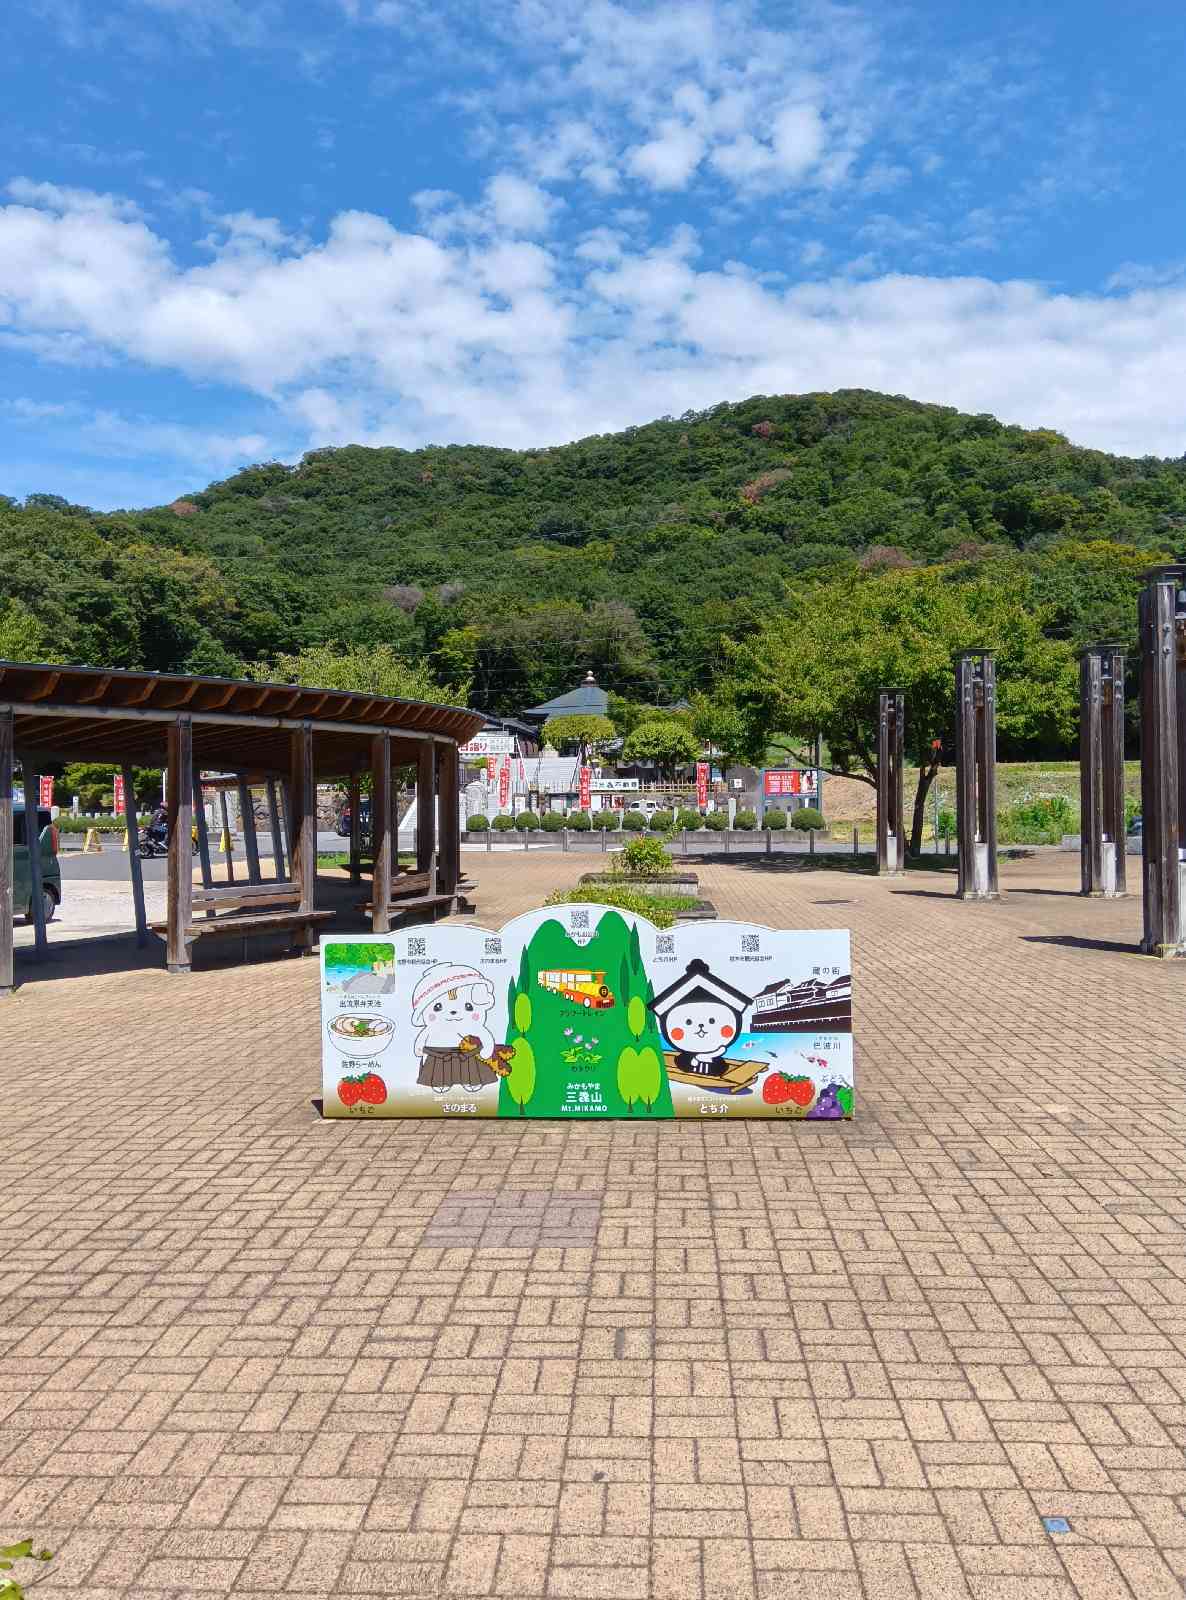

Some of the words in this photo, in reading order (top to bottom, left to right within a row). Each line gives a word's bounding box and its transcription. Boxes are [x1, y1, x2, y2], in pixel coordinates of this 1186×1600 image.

[812, 966, 840, 976] 蔵の街
[341, 1060, 382, 1069] 佐野らーめん
[566, 1082, 600, 1090] みかもやま
[565, 1091, 603, 1103] 三毳山
[349, 1105, 375, 1114] いちご
[443, 1103, 478, 1113] さのまる
[699, 1103, 729, 1114] とち介
[775, 1105, 802, 1114] いちご
